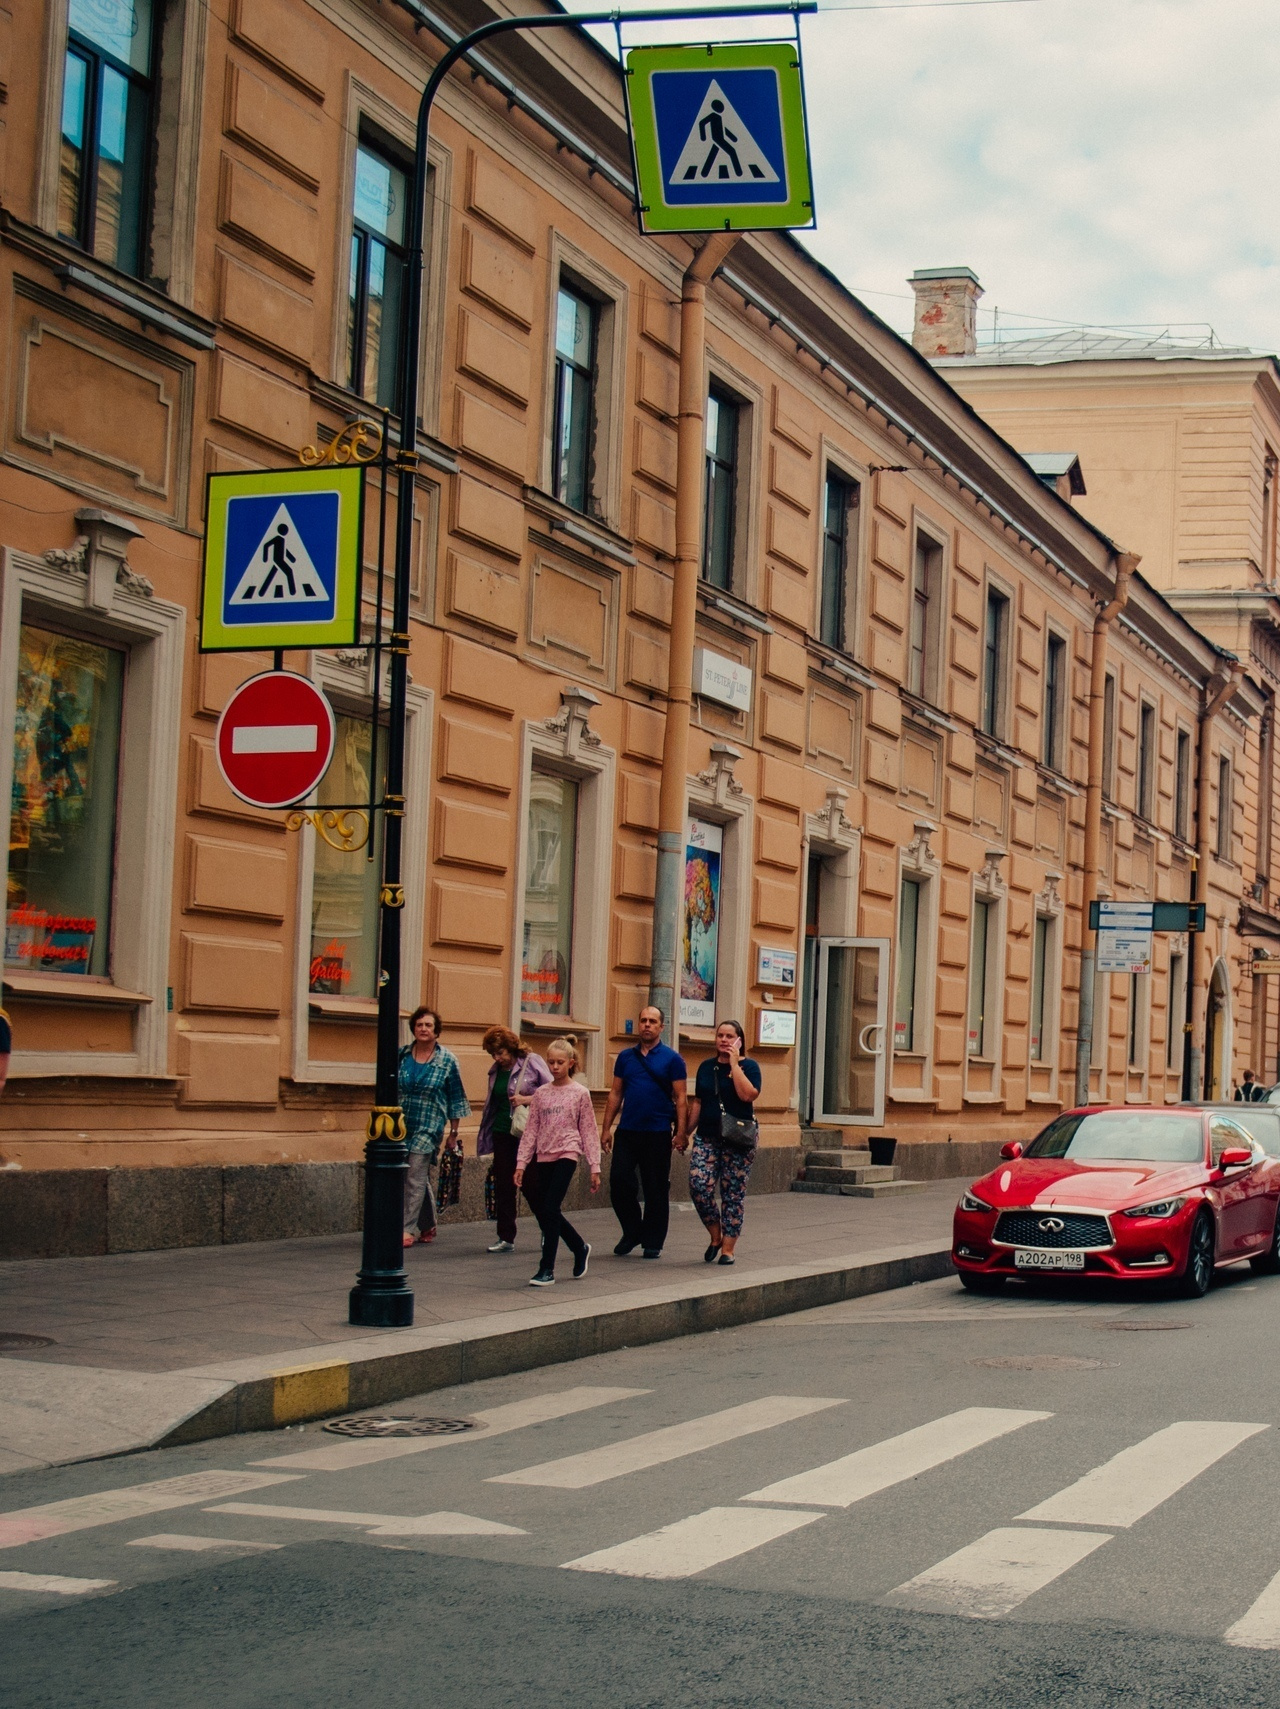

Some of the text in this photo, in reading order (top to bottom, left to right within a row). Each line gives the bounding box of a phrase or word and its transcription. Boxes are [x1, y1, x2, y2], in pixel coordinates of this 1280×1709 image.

[713, 672, 731, 688] PETER
[737, 681, 748, 695] LINE
[7, 902, 96, 933] Авторская
[323, 938, 346, 957] Art
[310, 956, 351, 986] Gallery
[688, 1005, 704, 1020] Gallery
[1065, 1253, 1082, 1262] 198
